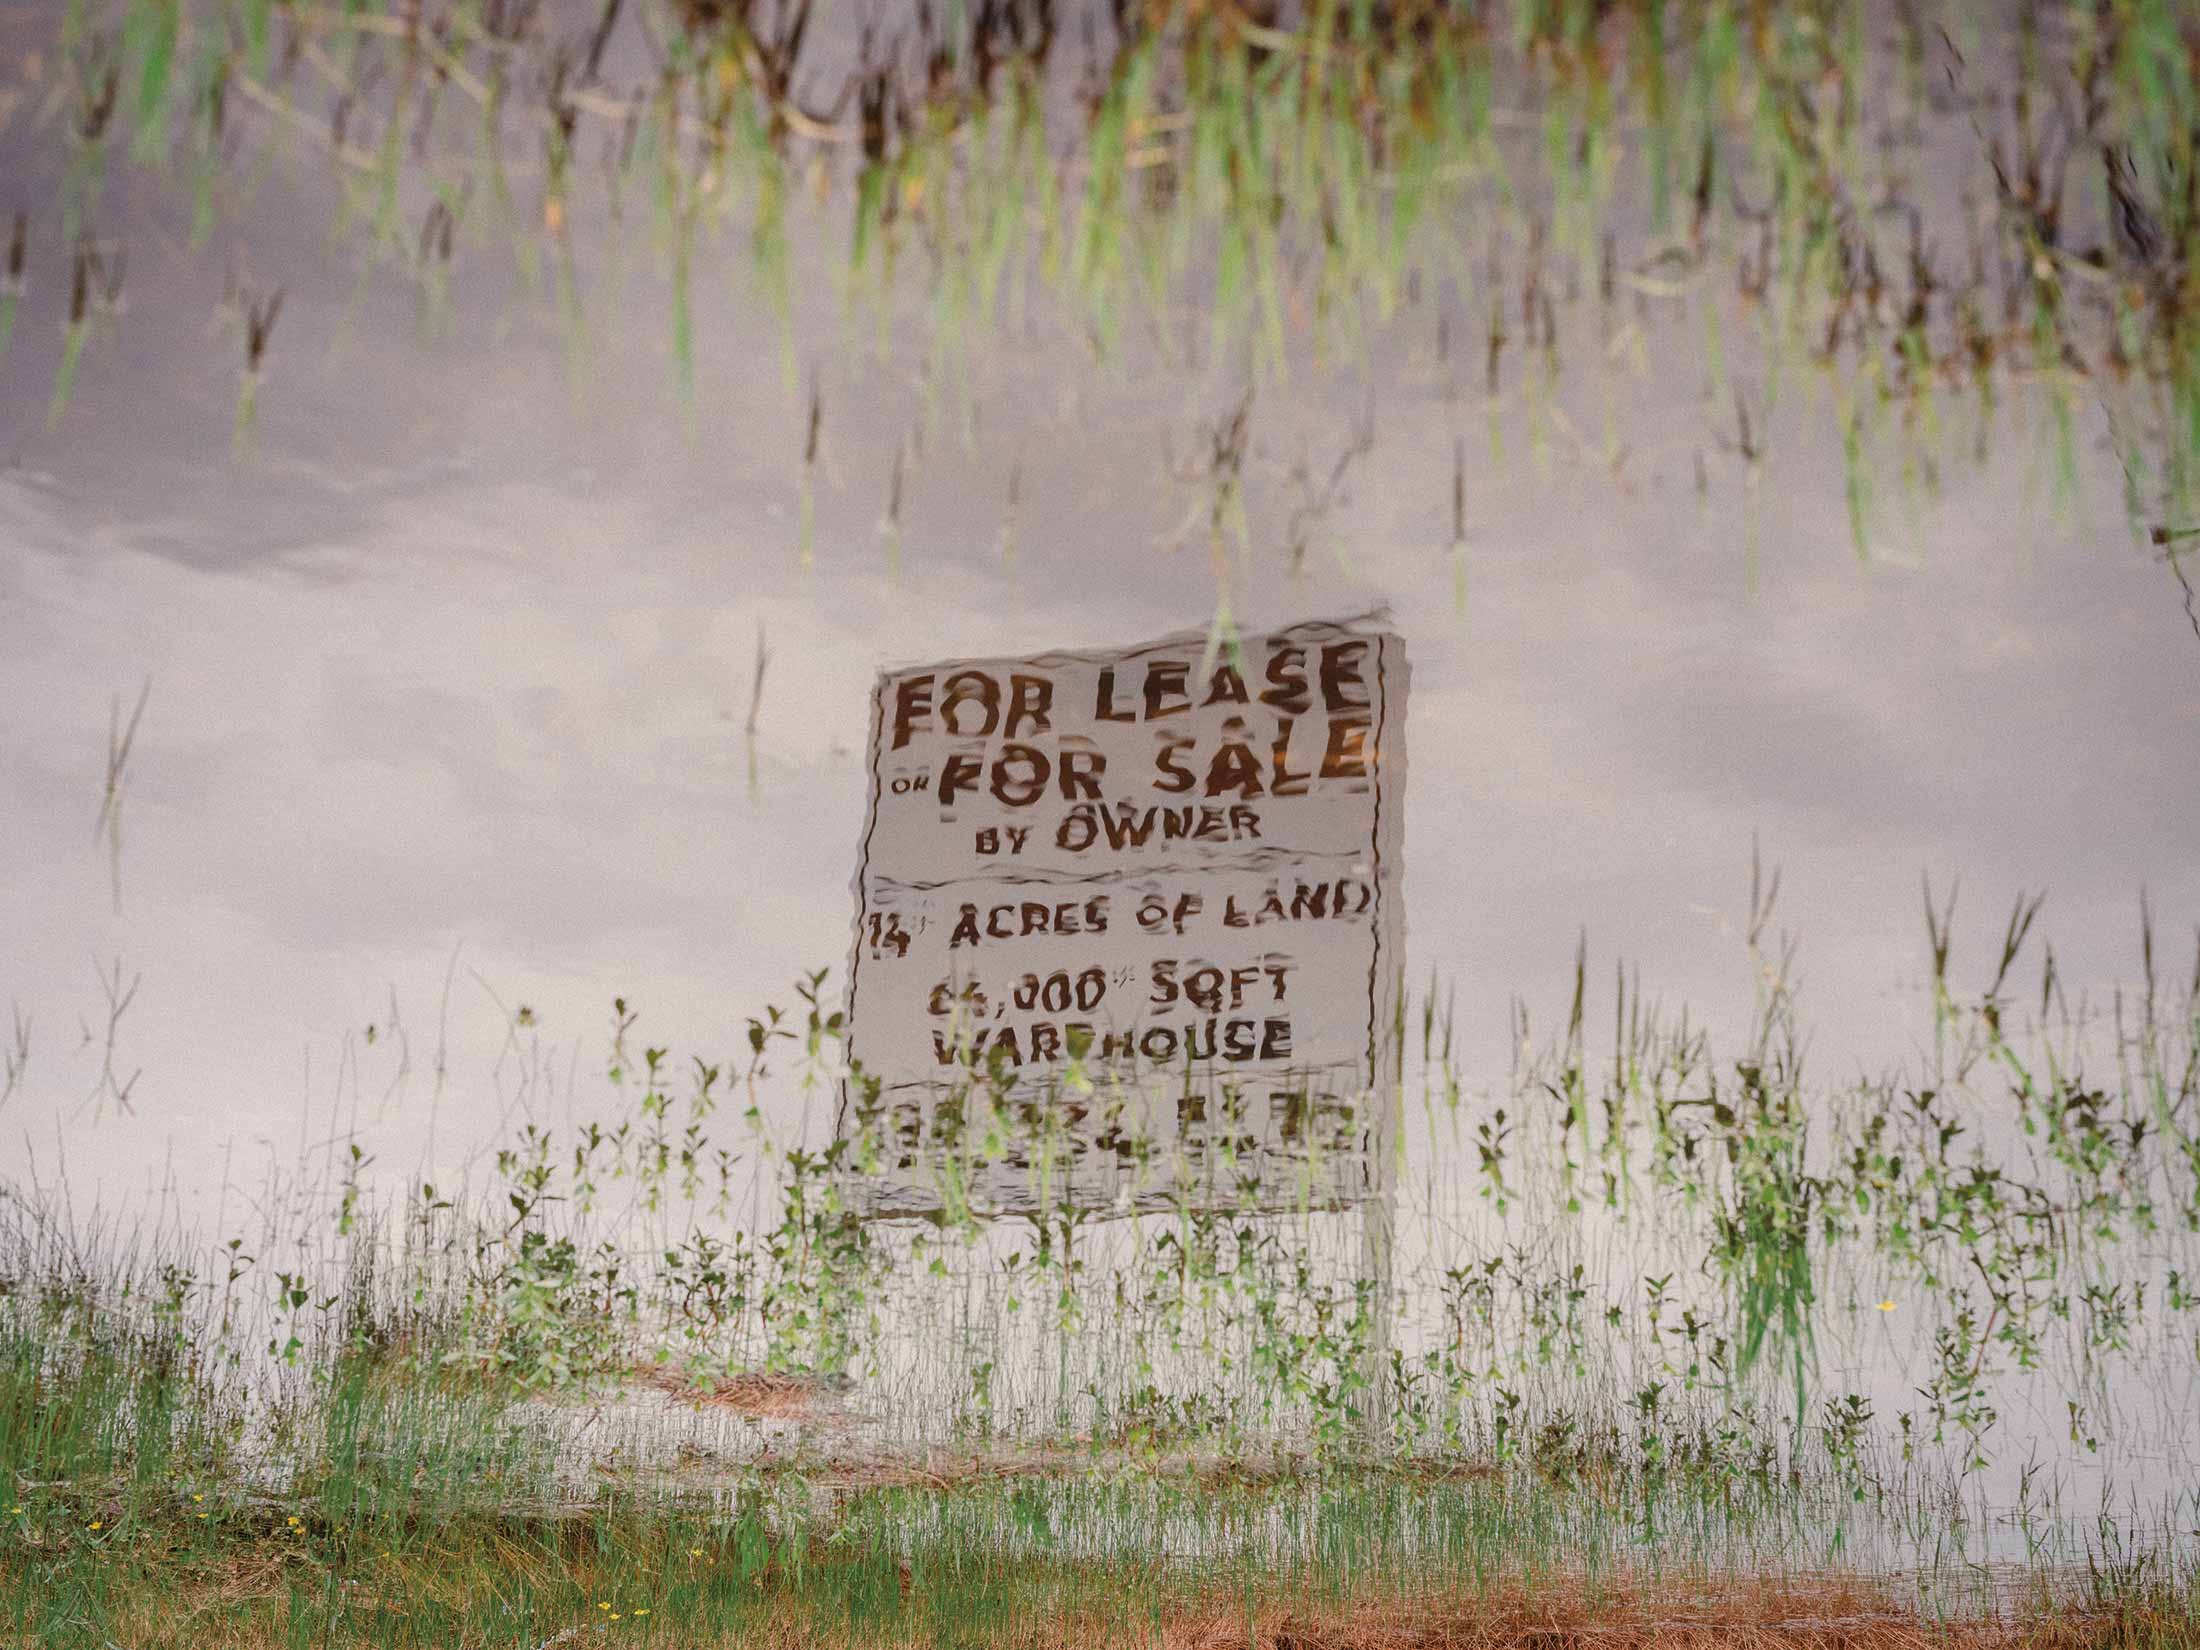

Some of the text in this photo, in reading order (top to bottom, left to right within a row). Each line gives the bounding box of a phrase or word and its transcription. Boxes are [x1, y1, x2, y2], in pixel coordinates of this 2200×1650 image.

[891, 638, 1371, 750] FOR LEASE
[939, 739, 1107, 808] FOR
[1153, 715, 1372, 797] SALE
[975, 799, 1262, 855] BY OWNER
[948, 896, 1110, 950] ACRES
[1136, 894, 1204, 936] OF
[1223, 880, 1372, 928] LAND
